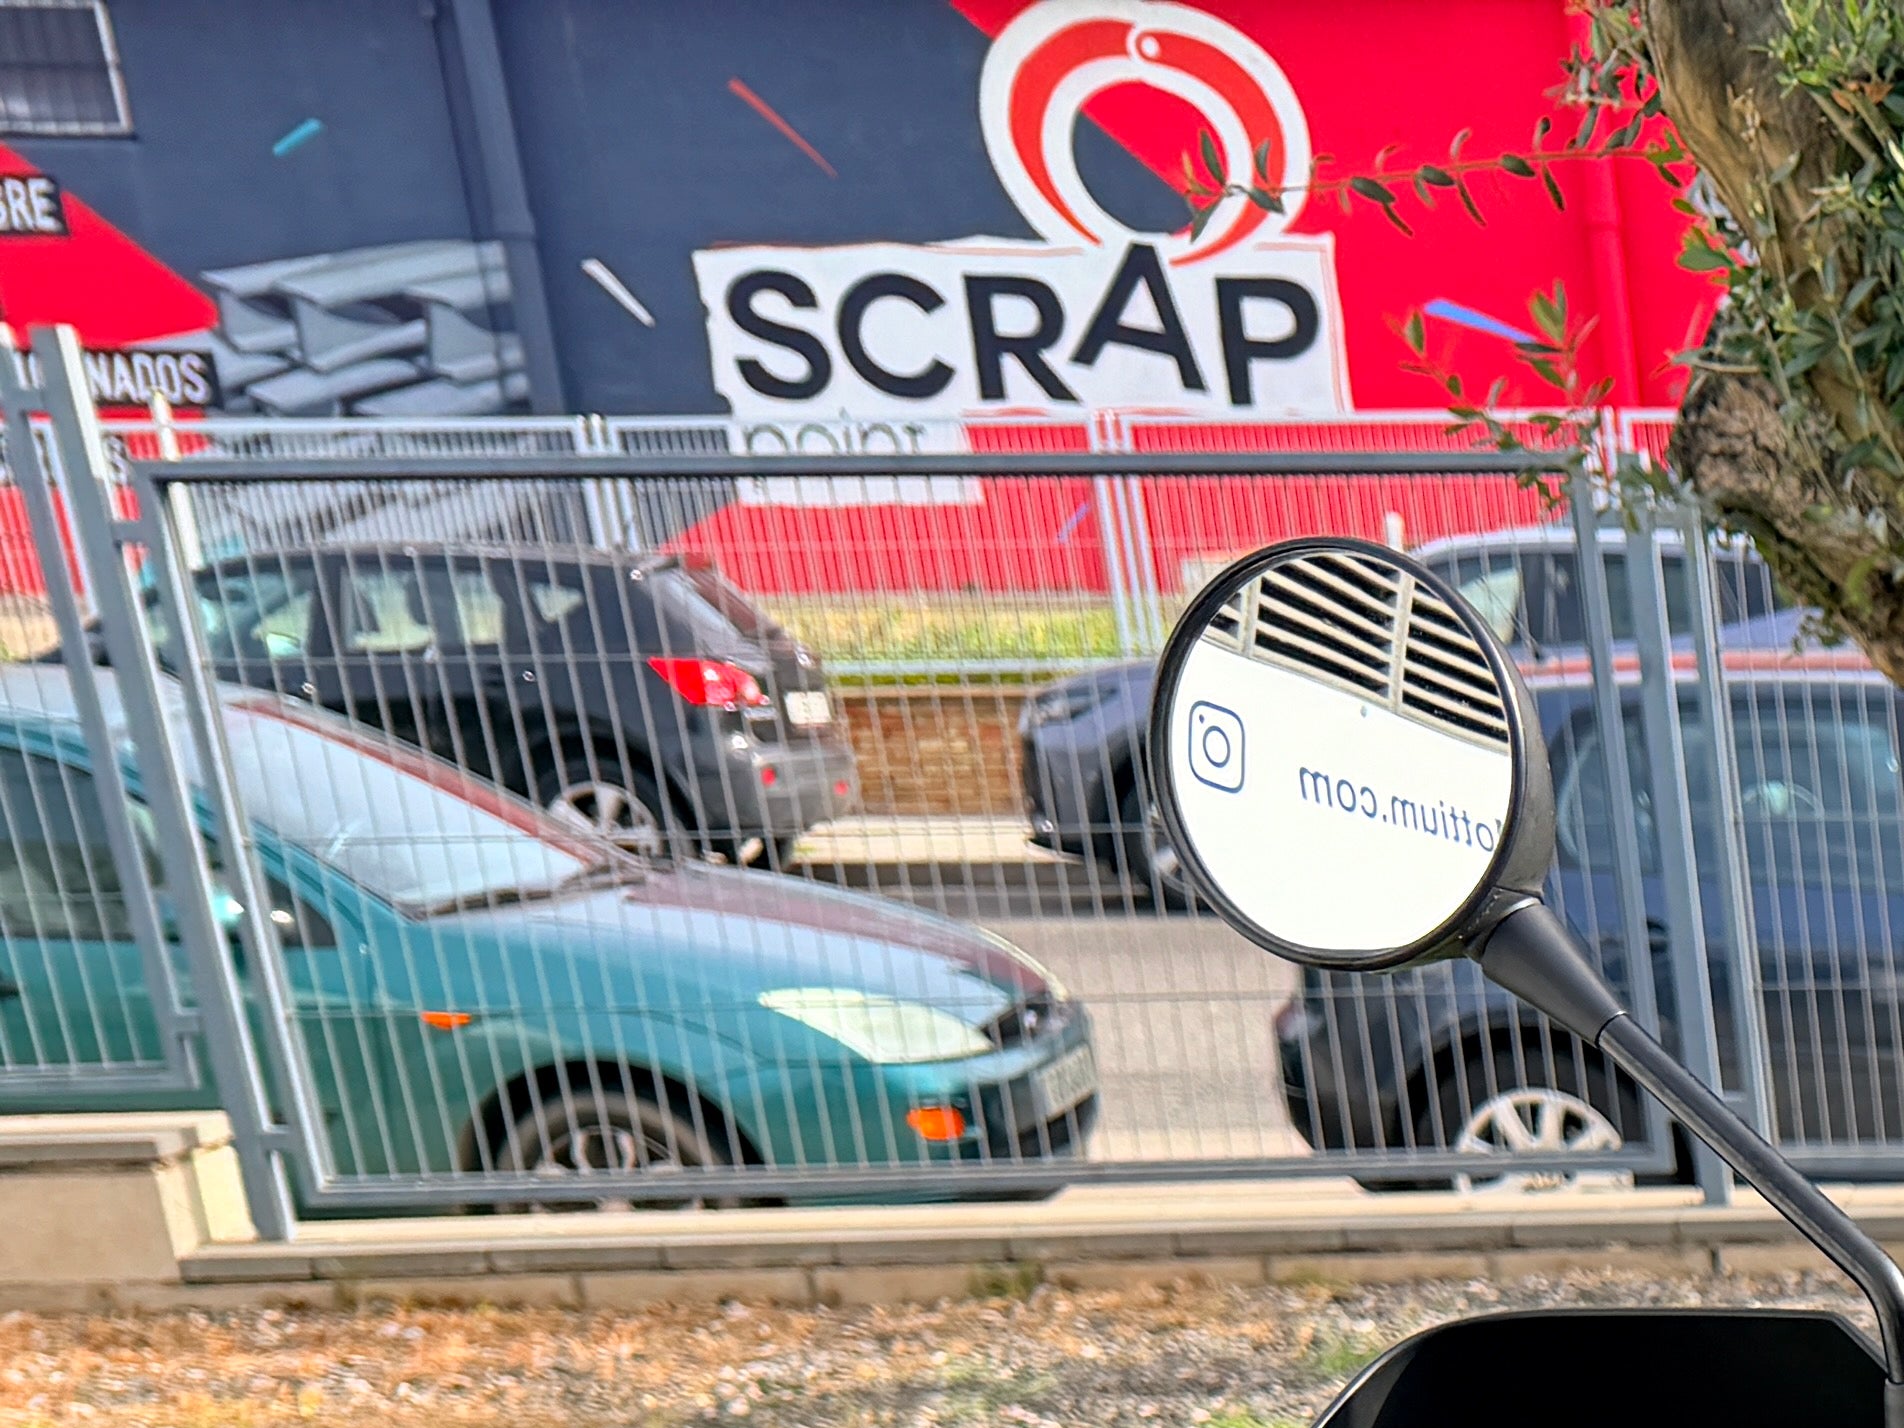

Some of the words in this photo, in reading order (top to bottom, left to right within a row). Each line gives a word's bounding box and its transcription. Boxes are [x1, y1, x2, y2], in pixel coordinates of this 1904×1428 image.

[0, 176, 63, 233] RE
[725, 242, 1321, 406] SCRAP
[83, 352, 212, 405] NADOS
